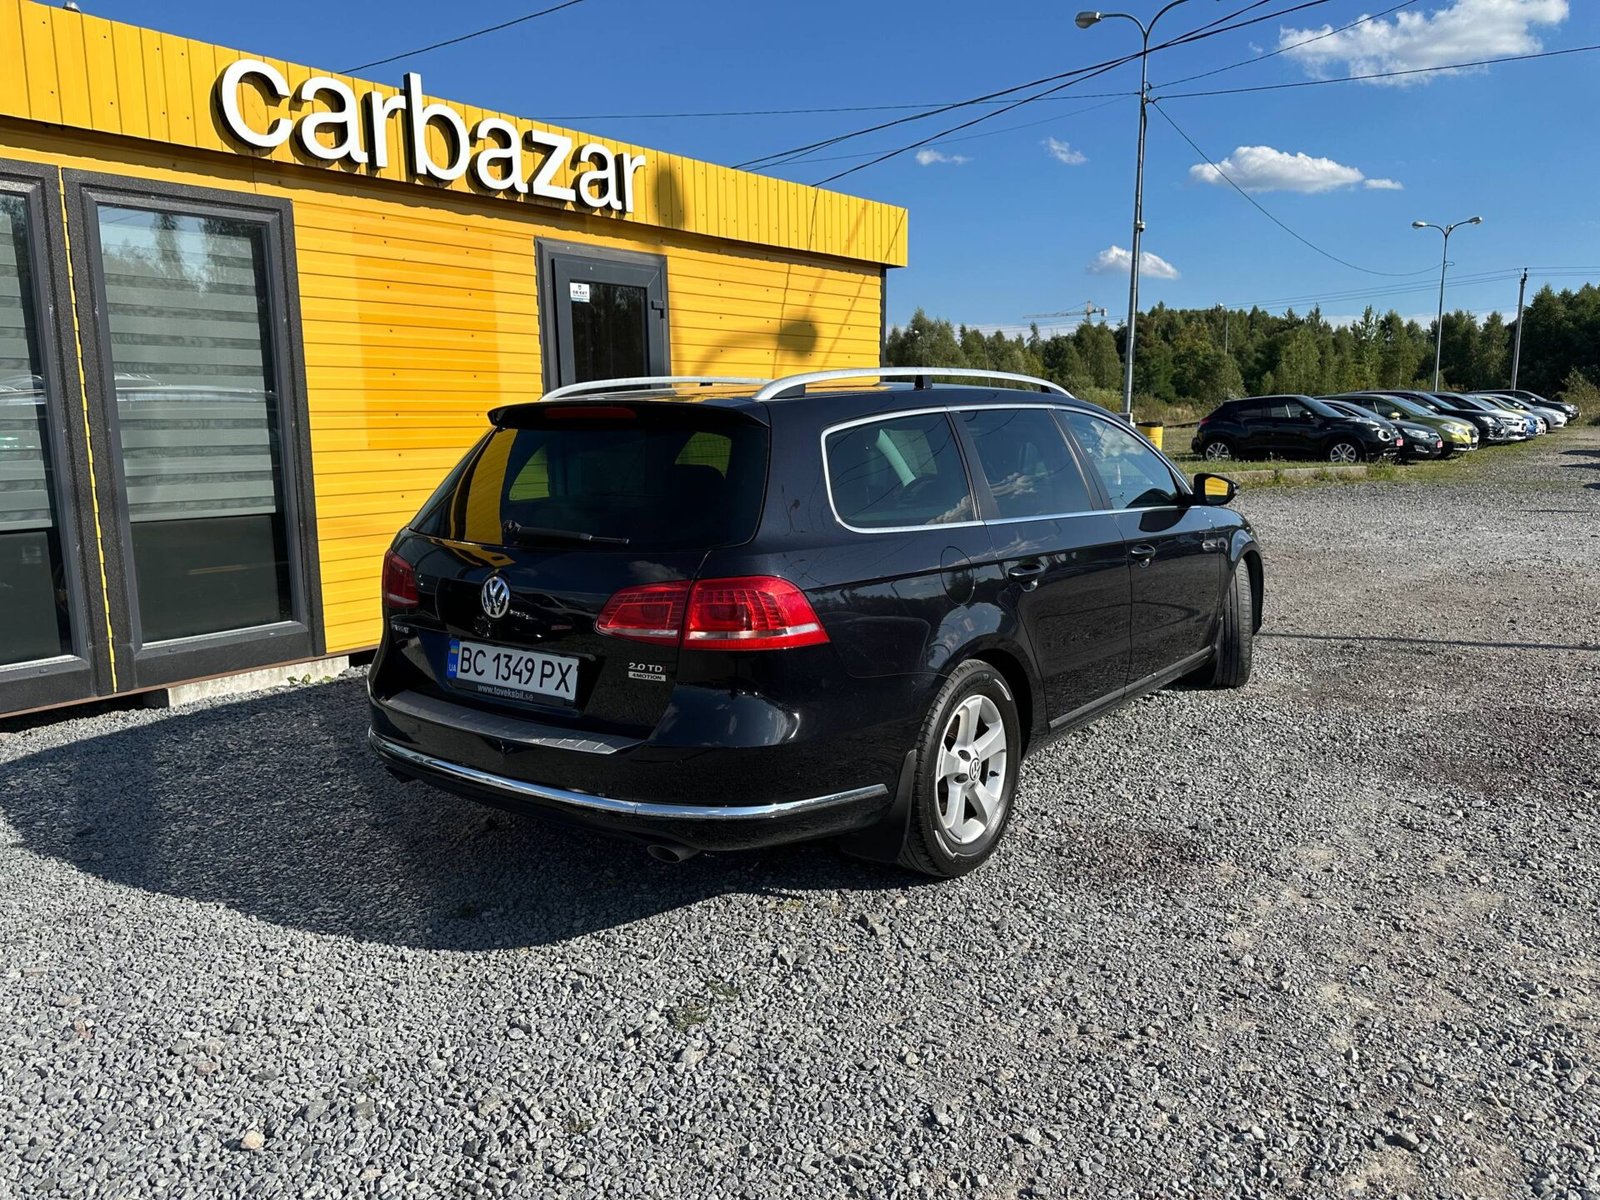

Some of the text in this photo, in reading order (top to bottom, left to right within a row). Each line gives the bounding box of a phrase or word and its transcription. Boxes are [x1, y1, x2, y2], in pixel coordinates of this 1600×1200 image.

[217, 58, 646, 213] carbazar
[448, 664, 457, 672] UA
[460, 646, 573, 693] BC 1349 PX
